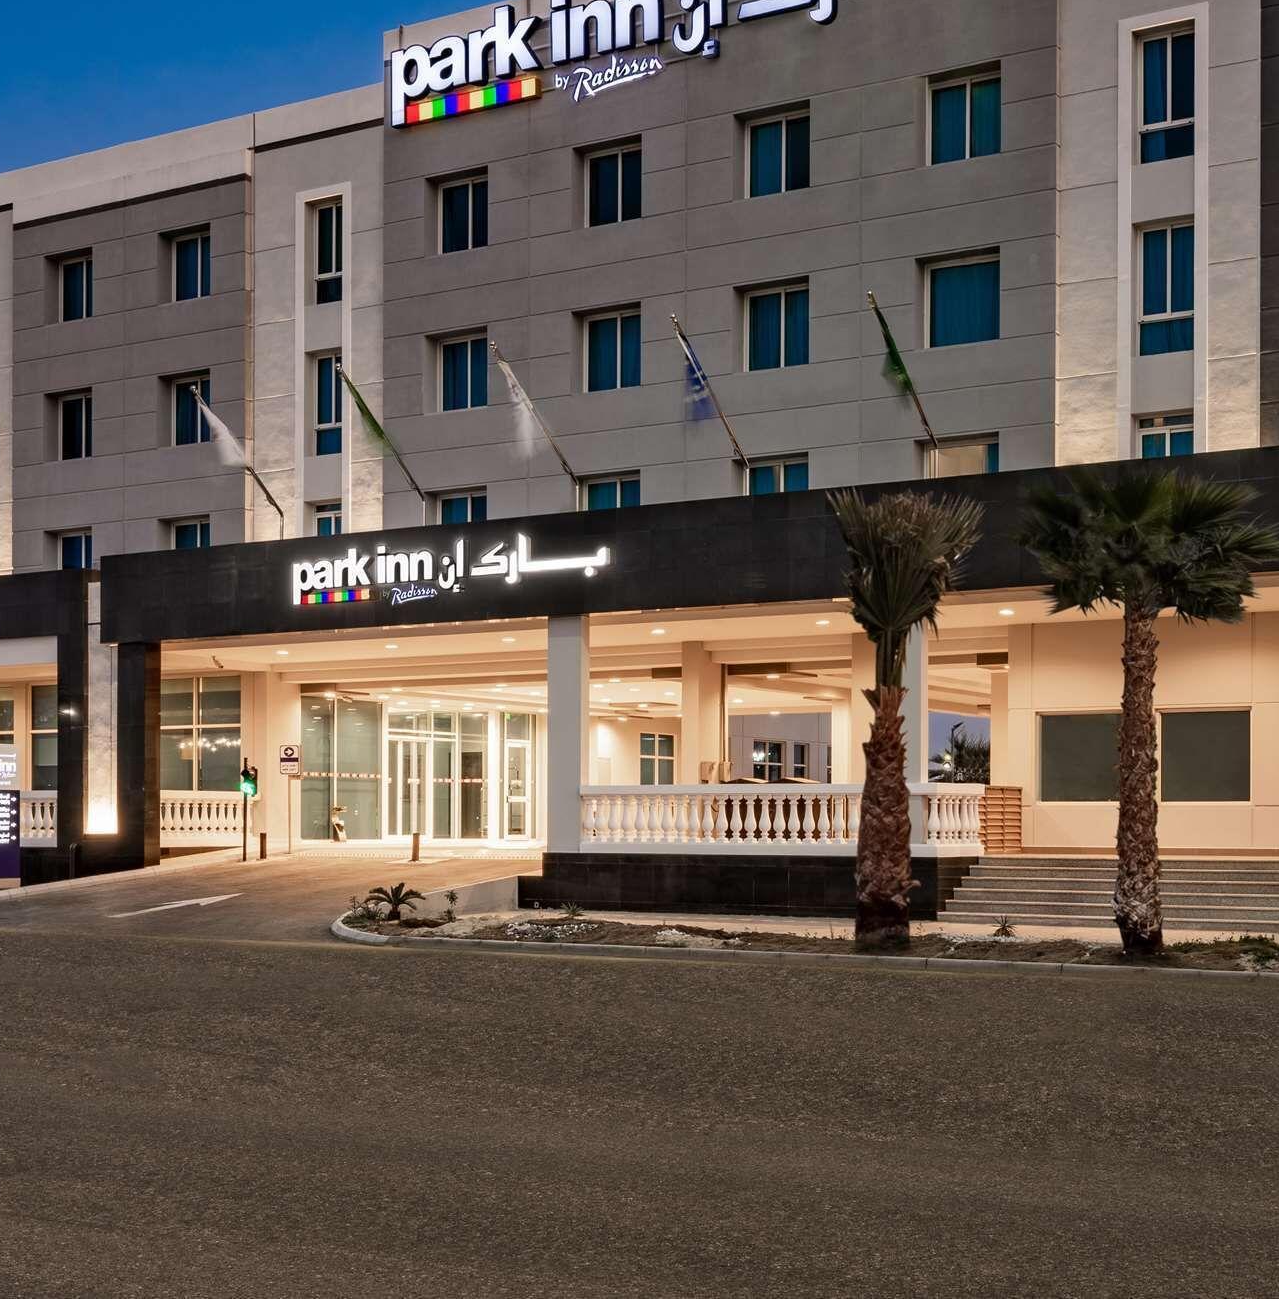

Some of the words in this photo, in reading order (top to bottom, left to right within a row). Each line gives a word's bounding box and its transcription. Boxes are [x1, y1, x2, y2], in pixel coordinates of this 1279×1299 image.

[390, 4, 543, 128] park
[555, 74, 570, 90] by
[573, 55, 663, 102] Radisson
[292, 547, 372, 605] park
[376, 545, 433, 584] inn
[391, 584, 438, 606] Radisson
